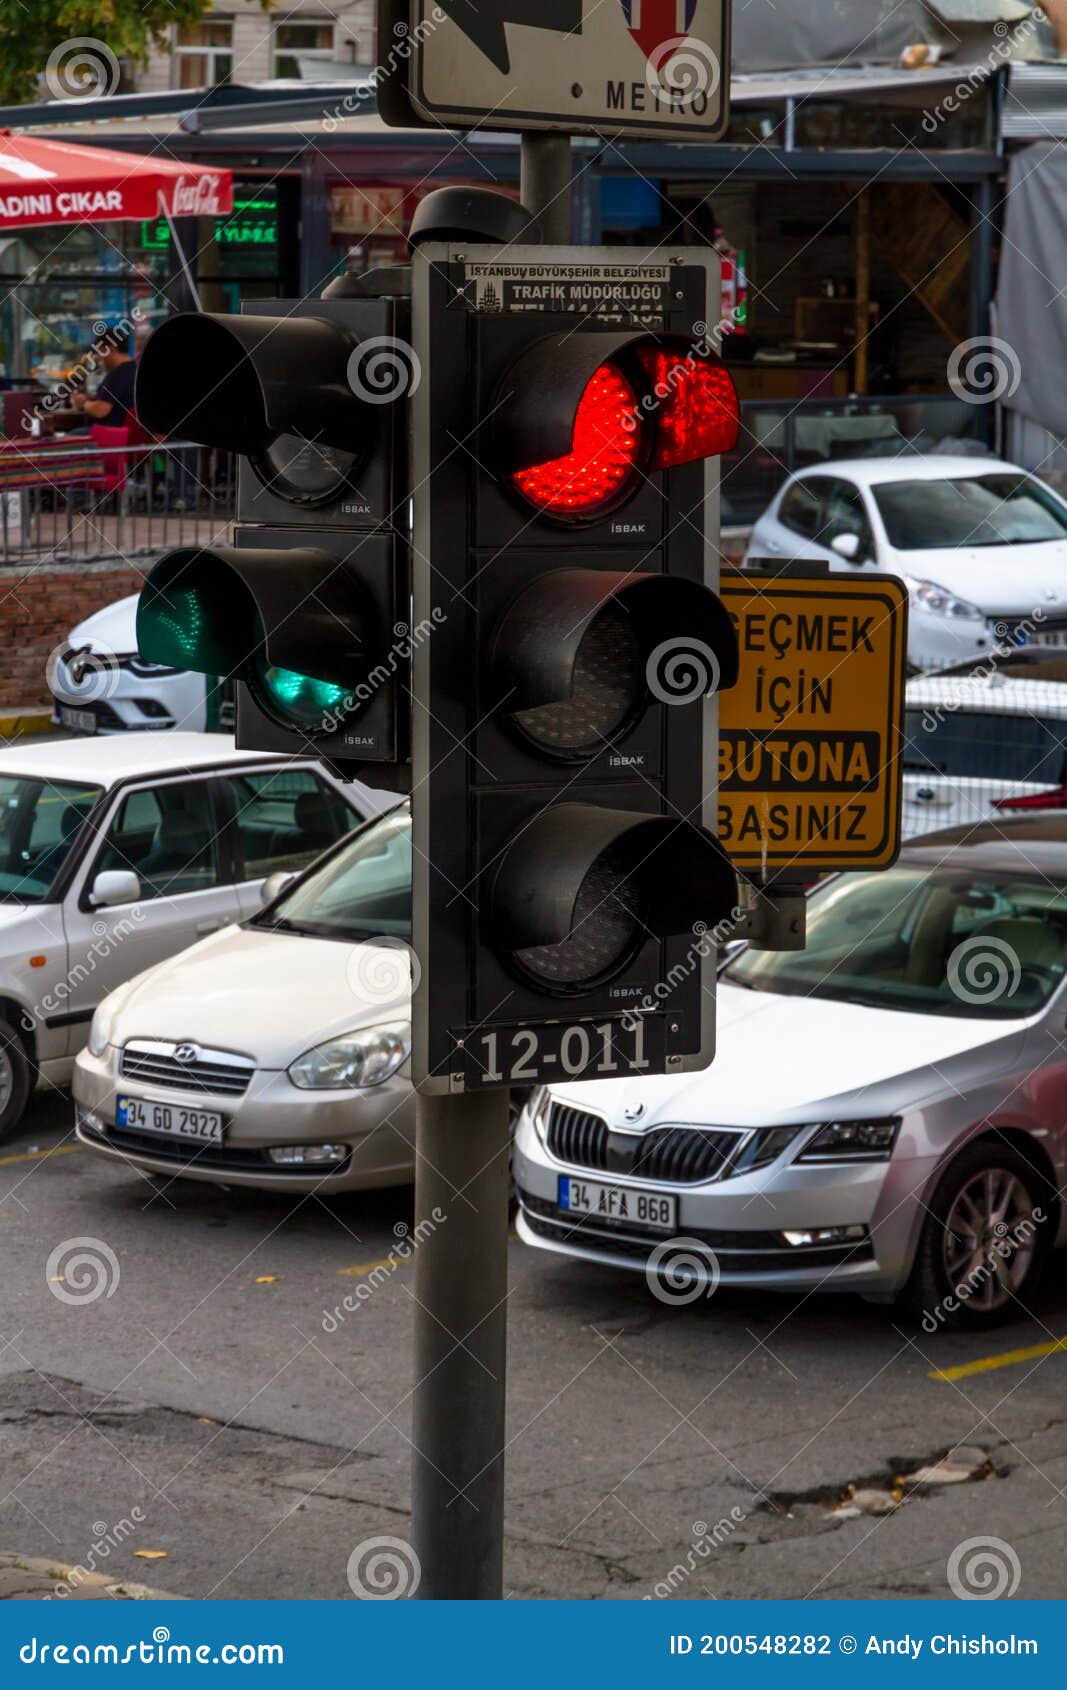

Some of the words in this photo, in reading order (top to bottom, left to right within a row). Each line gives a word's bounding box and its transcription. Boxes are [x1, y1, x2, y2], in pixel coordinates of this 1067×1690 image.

[607, 80, 708, 116] METRO
[56, 190, 123, 217] ÇIKAR
[529, 265, 600, 279] BÜYÜKŞEHİR
[512, 283, 566, 299] TRAFİK
[570, 283, 661, 300] MÜDÜRLÜĞÜ
[755, 665, 833, 724] İÇİN
[481, 1020, 650, 1082] 12-011
[127, 1102, 146, 1126] 34
[179, 1111, 217, 1138] 2922
[570, 1183, 590, 1209] 34
[598, 1189, 629, 1217] AFA
[637, 1196, 670, 1224] 868
